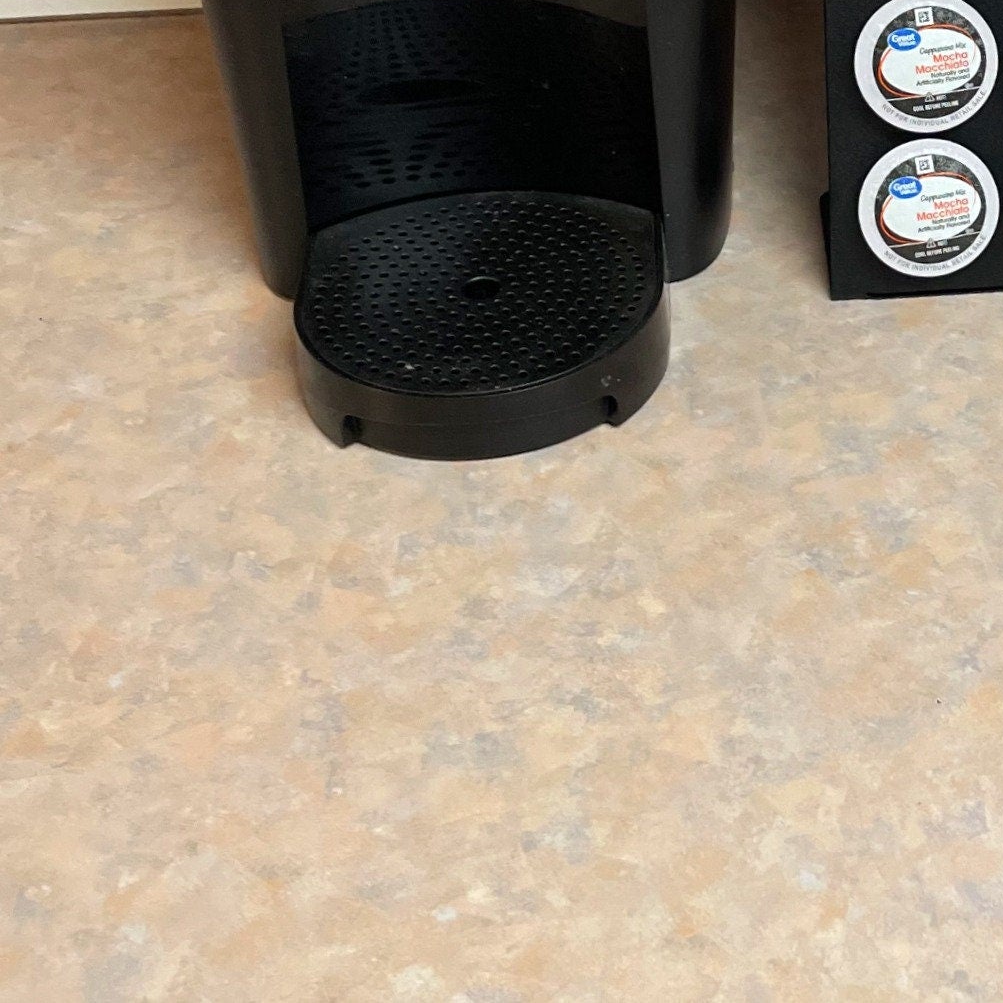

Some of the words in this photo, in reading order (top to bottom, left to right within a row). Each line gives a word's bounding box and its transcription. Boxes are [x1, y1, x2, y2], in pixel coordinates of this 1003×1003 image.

[933, 50, 968, 62] Mocha
[915, 59, 968, 73] Macchiato
[934, 197, 968, 209] Mocha
[917, 205, 969, 220] Macchiato
